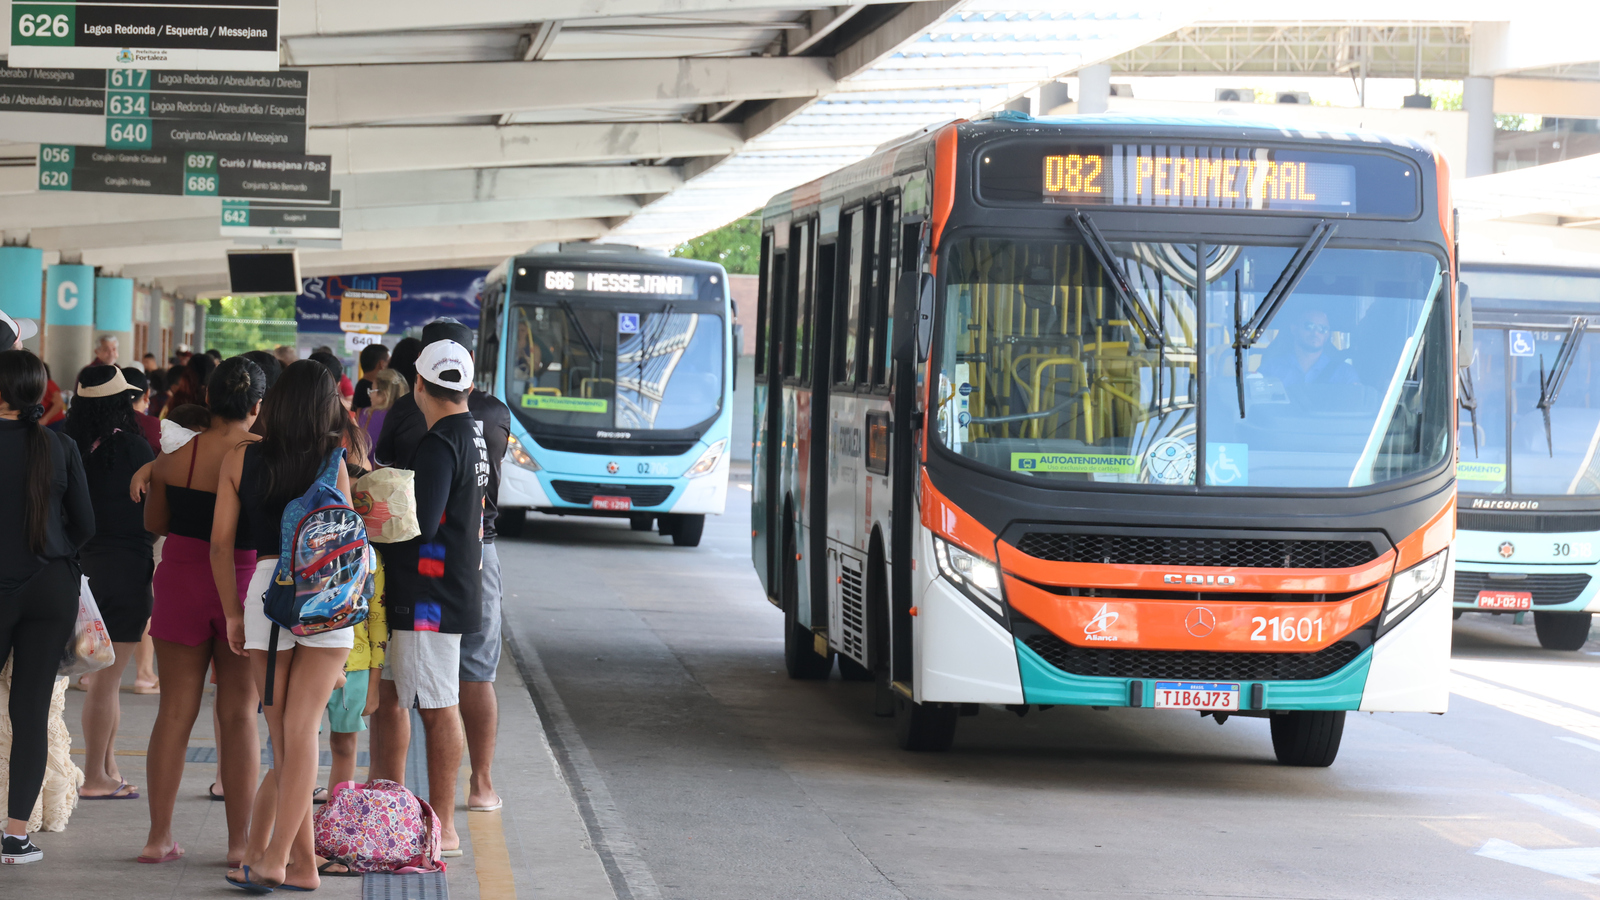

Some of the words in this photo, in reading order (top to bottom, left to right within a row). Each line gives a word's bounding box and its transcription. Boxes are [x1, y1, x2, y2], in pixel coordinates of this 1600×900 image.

[18, 13, 70, 38] 626
[84, 23, 113, 36] Lagoa
[114, 24, 156, 35] Redonda
[165, 25, 209, 37] Esquerda
[218, 26, 268, 39] Messejana
[34, 69, 75, 82] Messejana
[111, 69, 148, 87] 617
[158, 73, 183, 86] Lagoa
[183, 74, 219, 85] Redonda
[223, 75, 270, 87] Abreulândia
[277, 77, 302, 88] Direita
[16, 94, 62, 106] Abreulândia
[110, 95, 147, 115] 634
[151, 101, 176, 113] Lagoa
[176, 101, 212, 113] Redonda
[217, 102, 264, 114] Abreulândia
[270, 104, 305, 118] Esquerda
[110, 123, 148, 143] 640
[170, 129, 207, 143] Conjunto
[207, 130, 241, 142] Alvorada
[247, 132, 288, 145] Messejana
[42, 147, 71, 163] 056
[187, 154, 216, 169] 697
[219, 158, 246, 168] Curió
[252, 159, 302, 171] Messejana
[41, 171, 69, 187] 620
[188, 176, 216, 192] 686
[242, 180, 269, 191] Conjunto
[1135, 156, 1316, 201] PERIMETRAL
[223, 210, 247, 223] 642
[545, 270, 575, 290] 686
[587, 272, 683, 295] MESSEJANA
[57, 280, 79, 310] C
[352, 336, 373, 346] 640
[637, 462, 669, 476] 02706
[1040, 456, 1135, 466] AUTOATENDIMENTO
[1472, 498, 1539, 510] Marcopolo
[314, 533, 338, 548] TEAM
[1553, 543, 1593, 558] 30518
[1163, 573, 1236, 586] CAIO
[1250, 616, 1323, 642] 21601
[1085, 634, 1118, 642] Aliança
[1163, 690, 1231, 707] TIB6J73
